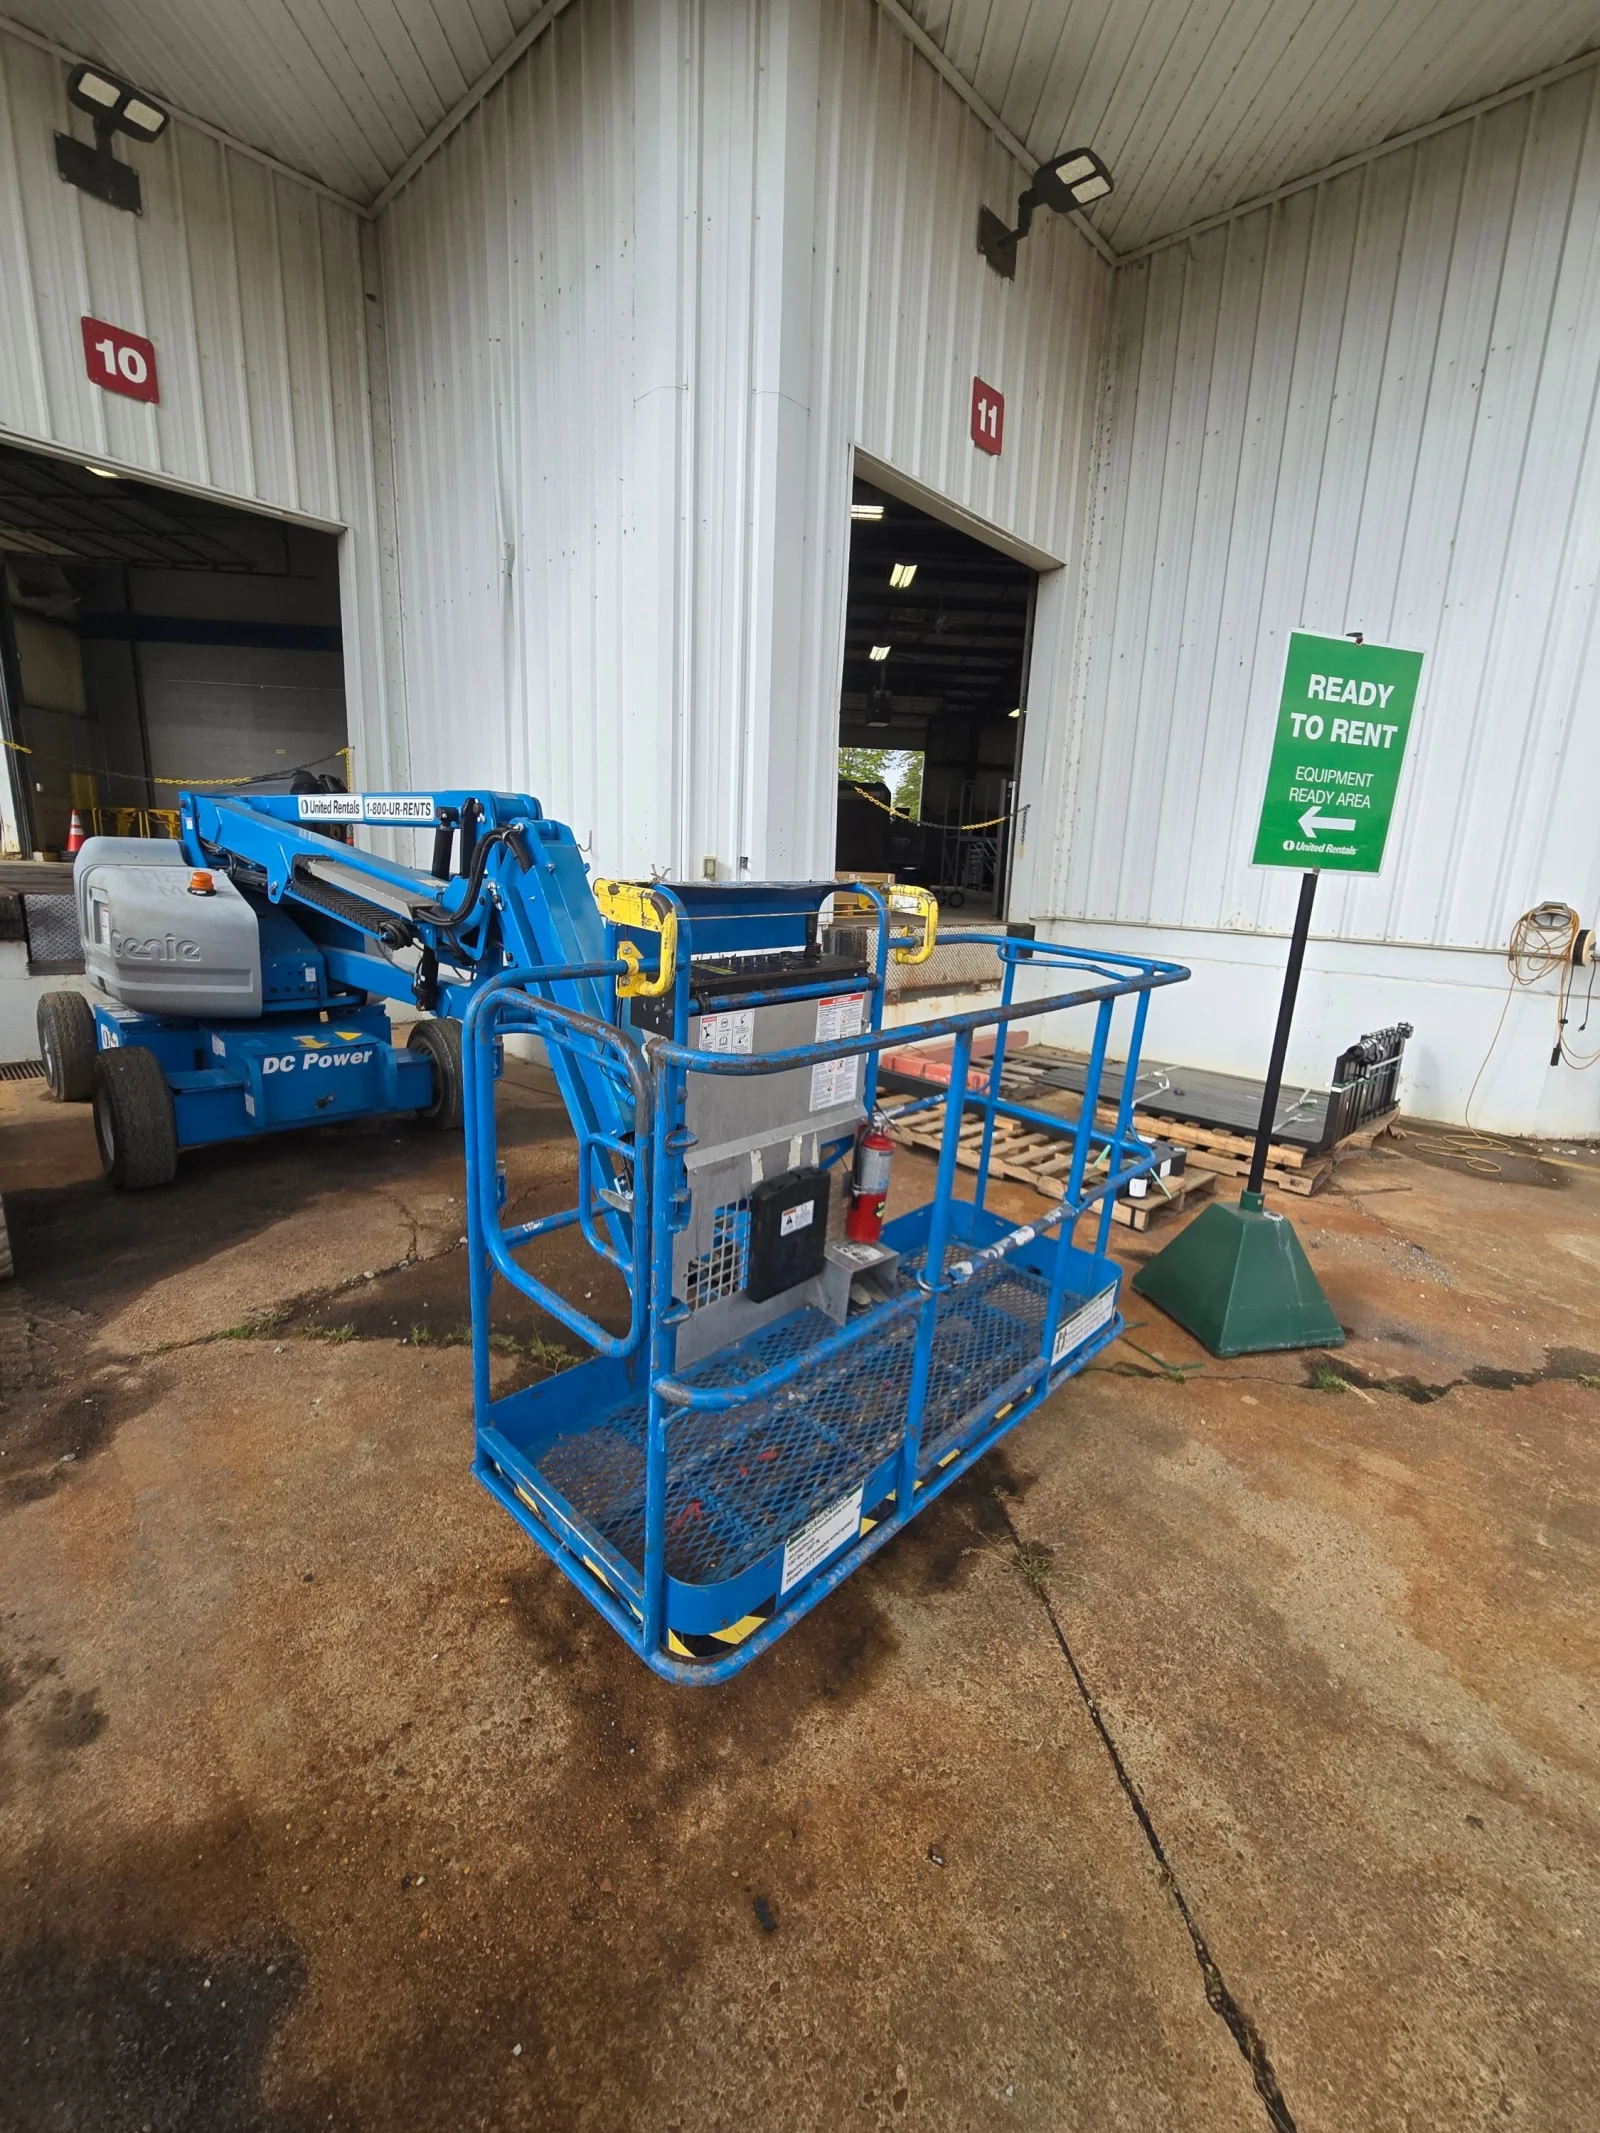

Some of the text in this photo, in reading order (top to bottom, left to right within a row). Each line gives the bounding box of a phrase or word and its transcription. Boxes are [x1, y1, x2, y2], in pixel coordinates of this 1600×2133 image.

[95, 338, 148, 384] 10
[977, 397, 998, 439] 11
[1307, 673, 1396, 709] READY
[1290, 712, 1399, 749] TO RENT
[1295, 765, 1375, 788] EQUIPMENT
[309, 799, 332, 815] United
[333, 799, 360, 815] Rentals
[1288, 787, 1371, 809] READY AREA
[1295, 841, 1357, 856] United Rentals
[262, 1050, 373, 1075] DC Power
